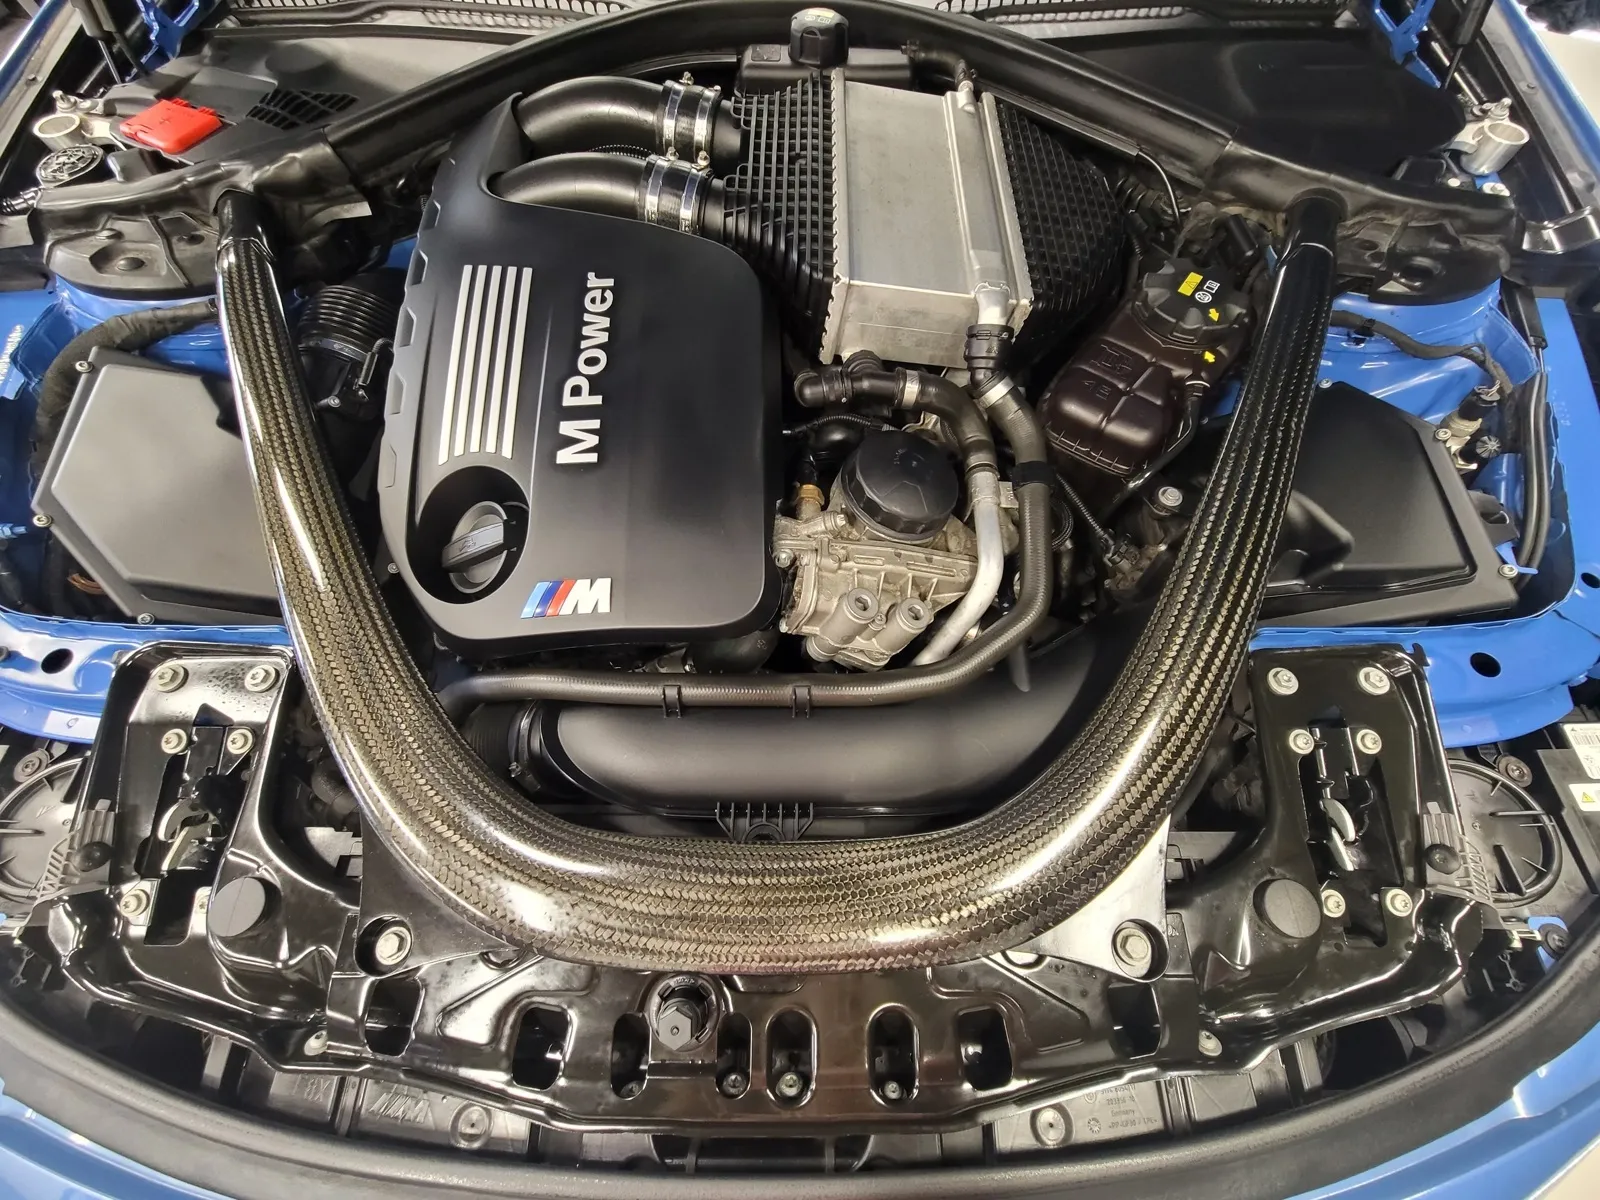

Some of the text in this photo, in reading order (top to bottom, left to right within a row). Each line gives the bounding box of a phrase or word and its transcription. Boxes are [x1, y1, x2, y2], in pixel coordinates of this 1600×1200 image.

[555, 271, 615, 464] M Power
[1110, 1109, 1135, 1118] Germany
